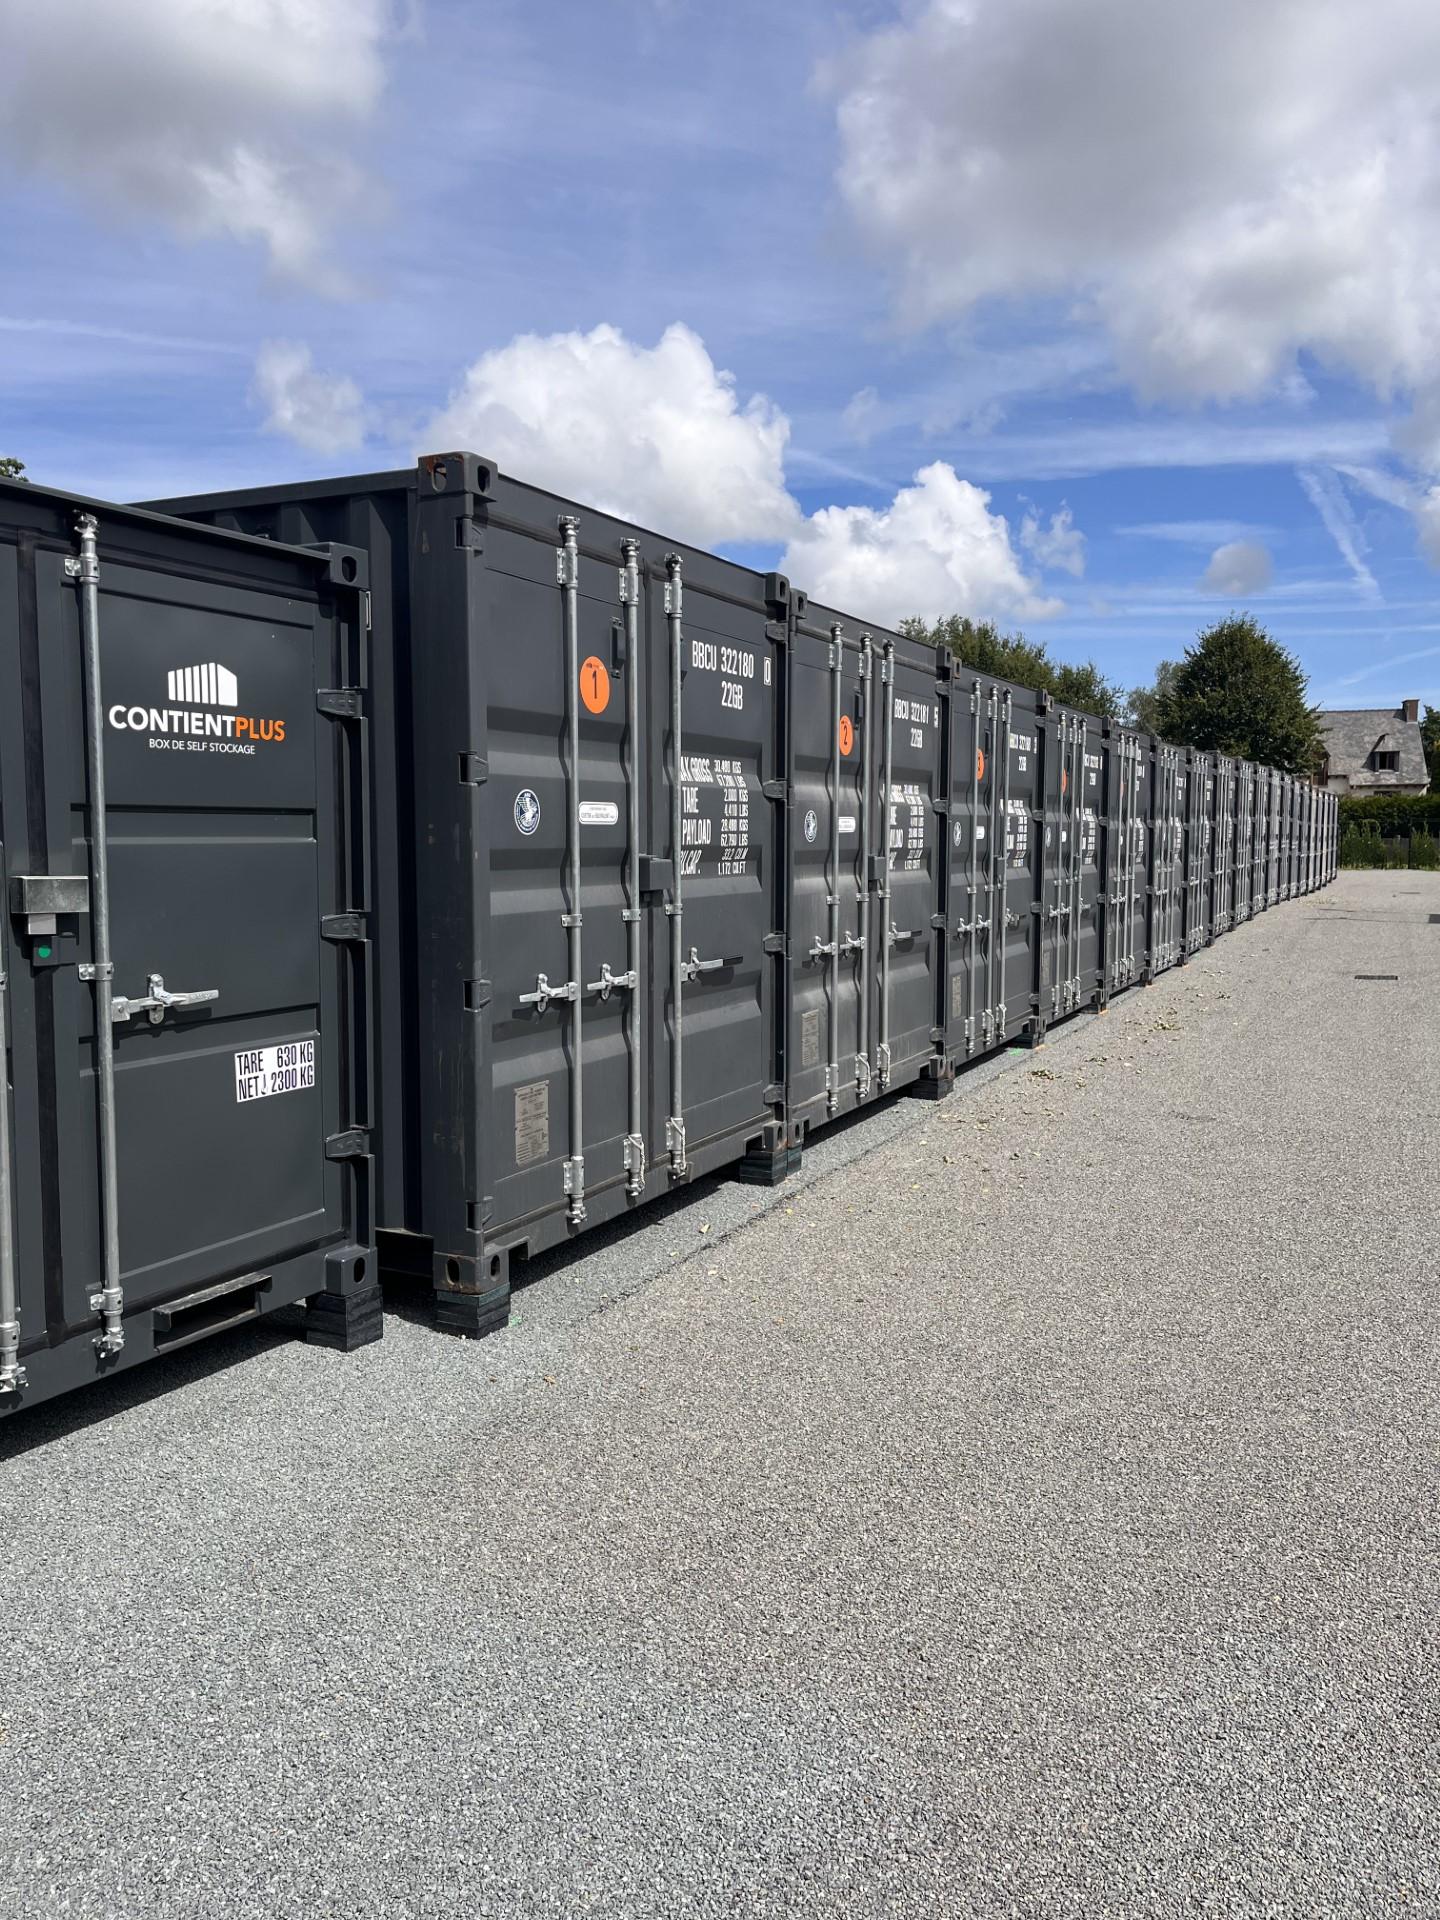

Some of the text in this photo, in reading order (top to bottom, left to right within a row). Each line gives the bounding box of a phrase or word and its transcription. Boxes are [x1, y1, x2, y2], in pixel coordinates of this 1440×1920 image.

[692, 640, 717, 671] BBCU
[721, 646, 754, 678] 322180
[592, 670, 597, 699] 1
[721, 681, 743, 710] 22GB
[109, 705, 285, 742] CONTIENTPLUS
[843, 724, 848, 746] 2
[149, 738, 256, 755] BOX DE SELF STOCKAGE
[680, 756, 694, 781] AX
[682, 786, 699, 813] TARE
[682, 819, 712, 846] PAYLOAD
[738, 833, 749, 847] LBS
[237, 1042, 313, 1076] TARE 630 KG
[238, 1065, 313, 1101] NET 2300 KG
